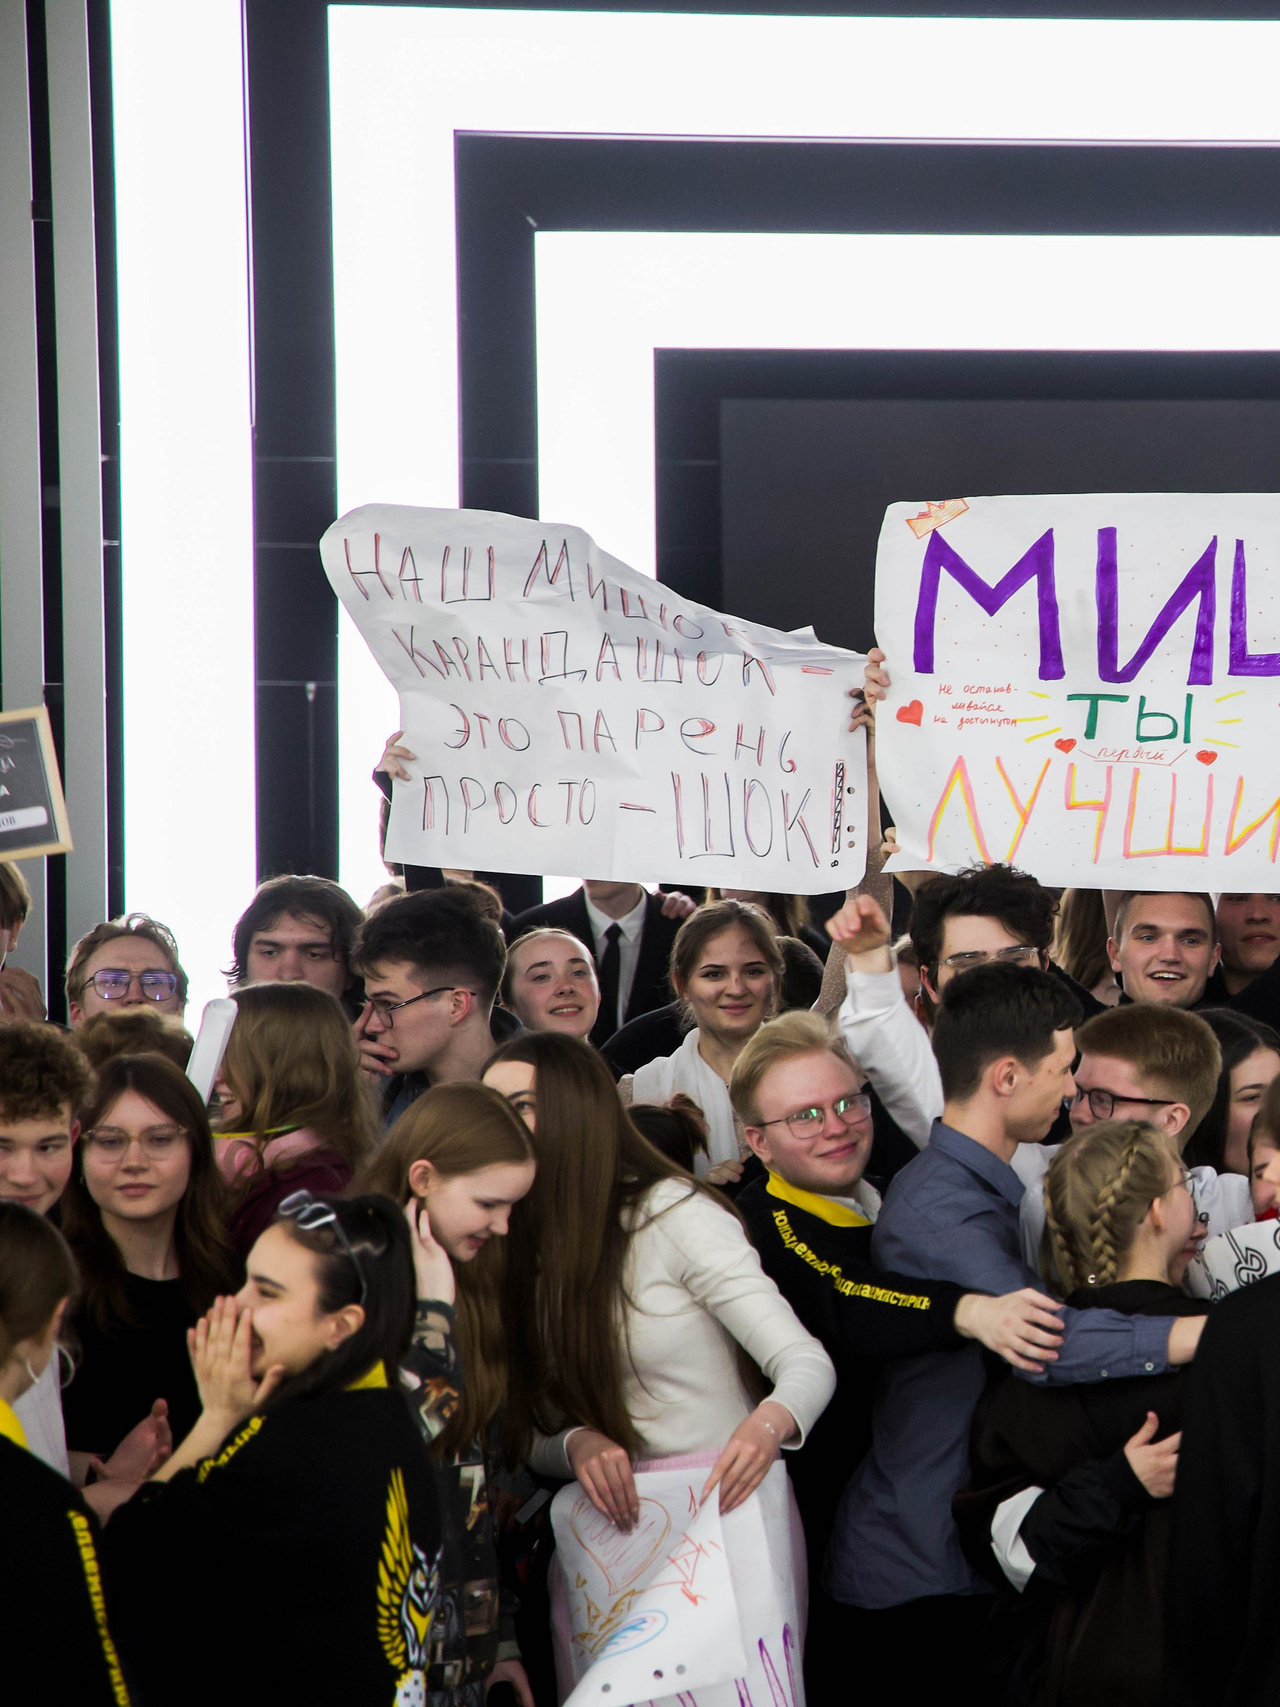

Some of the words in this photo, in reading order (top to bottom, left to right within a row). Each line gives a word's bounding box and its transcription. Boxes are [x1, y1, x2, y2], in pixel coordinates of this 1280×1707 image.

[344, 532, 496, 605] НАШ
[391, 625, 777, 697] КАРАНДАШОК
[444, 702, 531, 753] ЭТО
[1067, 693, 1193, 744] ТЫ
[1097, 745, 1168, 763] первый
[422, 775, 597, 836] ПРОСТО
